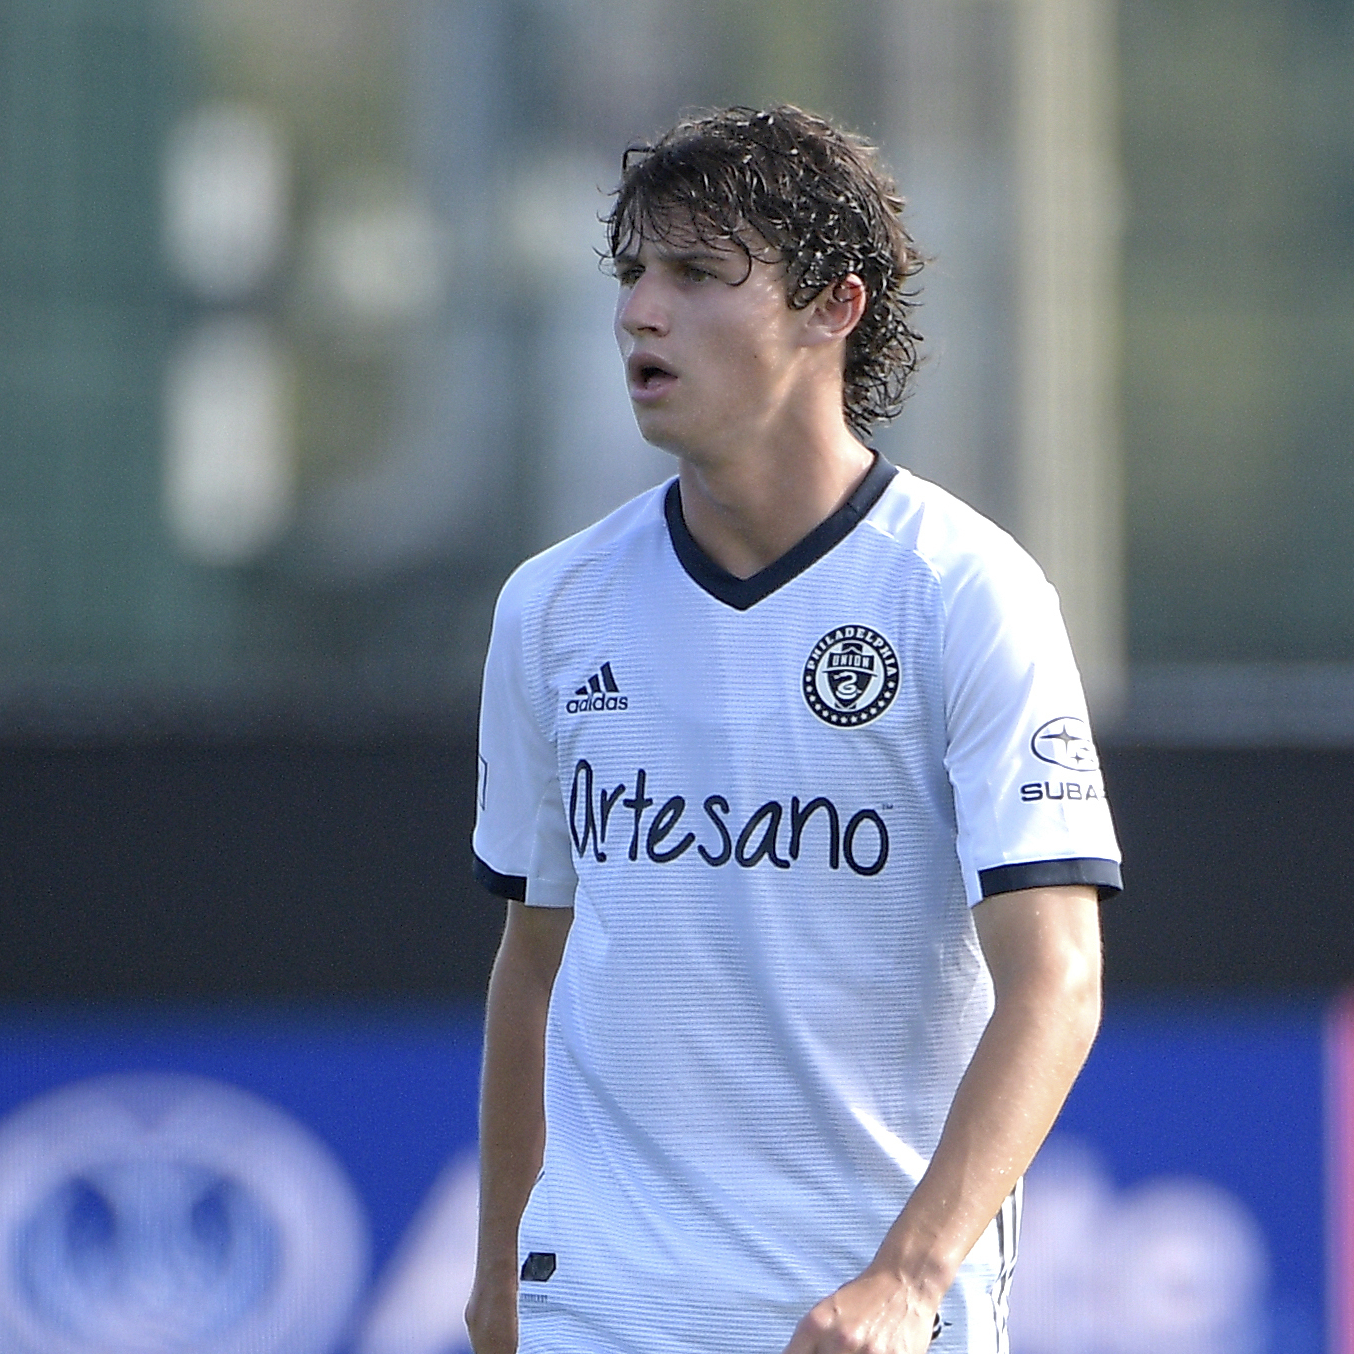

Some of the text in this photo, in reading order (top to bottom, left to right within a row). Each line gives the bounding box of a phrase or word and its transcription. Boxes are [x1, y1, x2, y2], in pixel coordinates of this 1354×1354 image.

[806, 626, 898, 677] PHILADELPHIA
[832, 654, 870, 668] UNION
[566, 692, 629, 714] adidas
[1020, 782, 1106, 802] SUBA
[570, 759, 889, 877] Artesano
